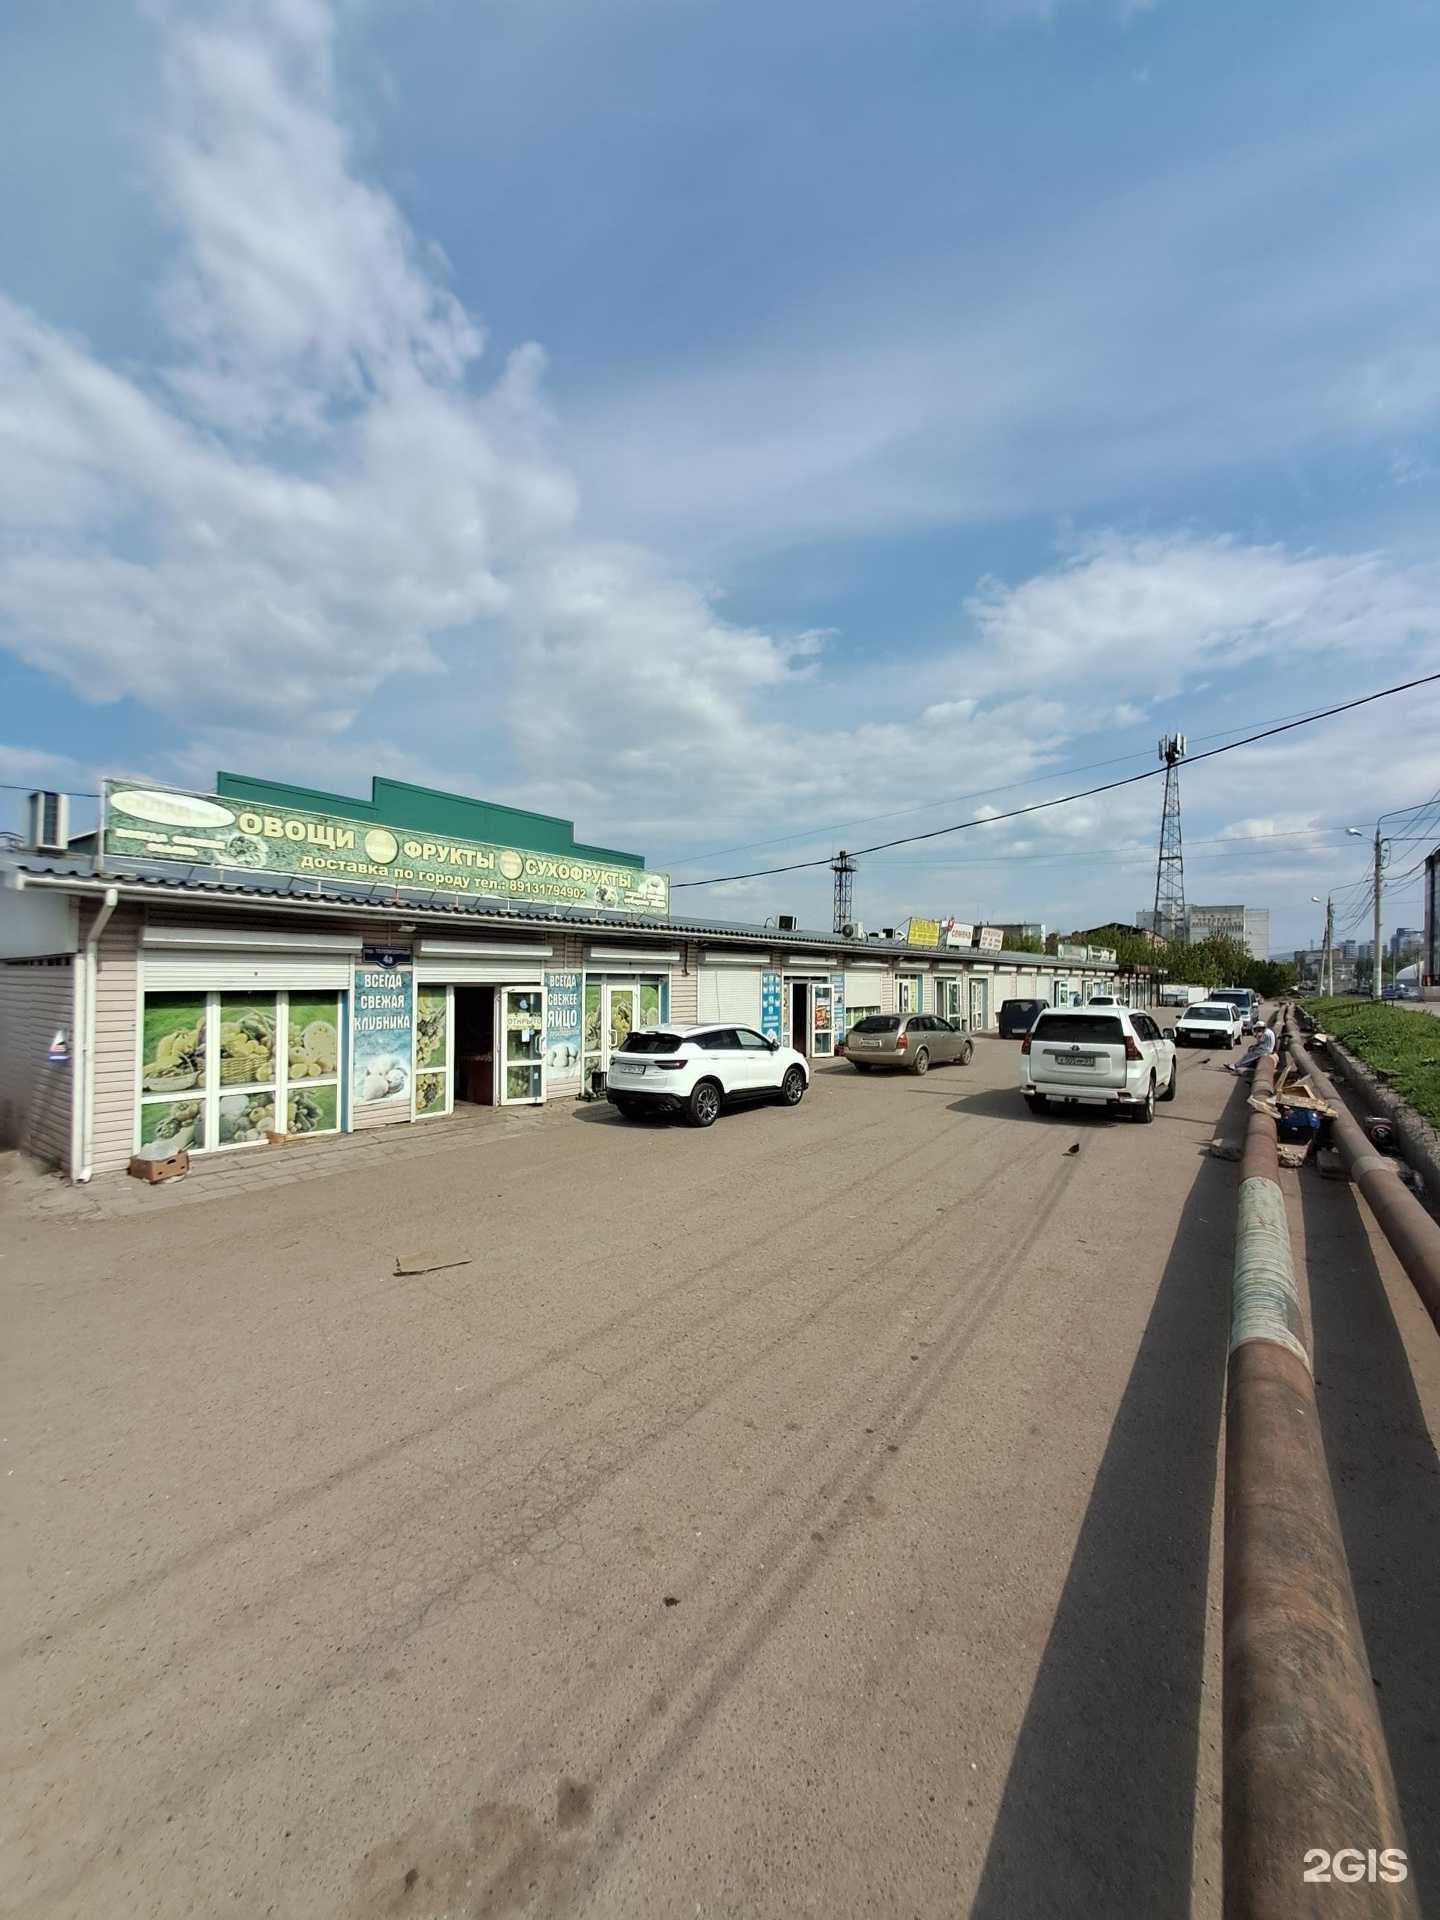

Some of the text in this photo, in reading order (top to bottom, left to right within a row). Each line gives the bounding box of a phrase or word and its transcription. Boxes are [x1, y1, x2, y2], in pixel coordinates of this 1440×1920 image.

[238, 812, 356, 850] ОВОЩИ
[403, 841, 495, 869] ФРУКТЫ
[525, 858, 633, 888] СУХОФРУКТЫ
[301, 856, 586, 899] доставка по городу тел.: 89131794902
[364, 974, 402, 989] ВСЕГДА
[549, 975, 577, 988] ВСЕГДА
[361, 994, 405, 1009] СВЕЖАЯ
[548, 993, 577, 1005] СВЕЖЕЕ
[354, 1014, 411, 1030] КЛУБНИКА
[547, 1008, 578, 1028] ЯЙЦО
